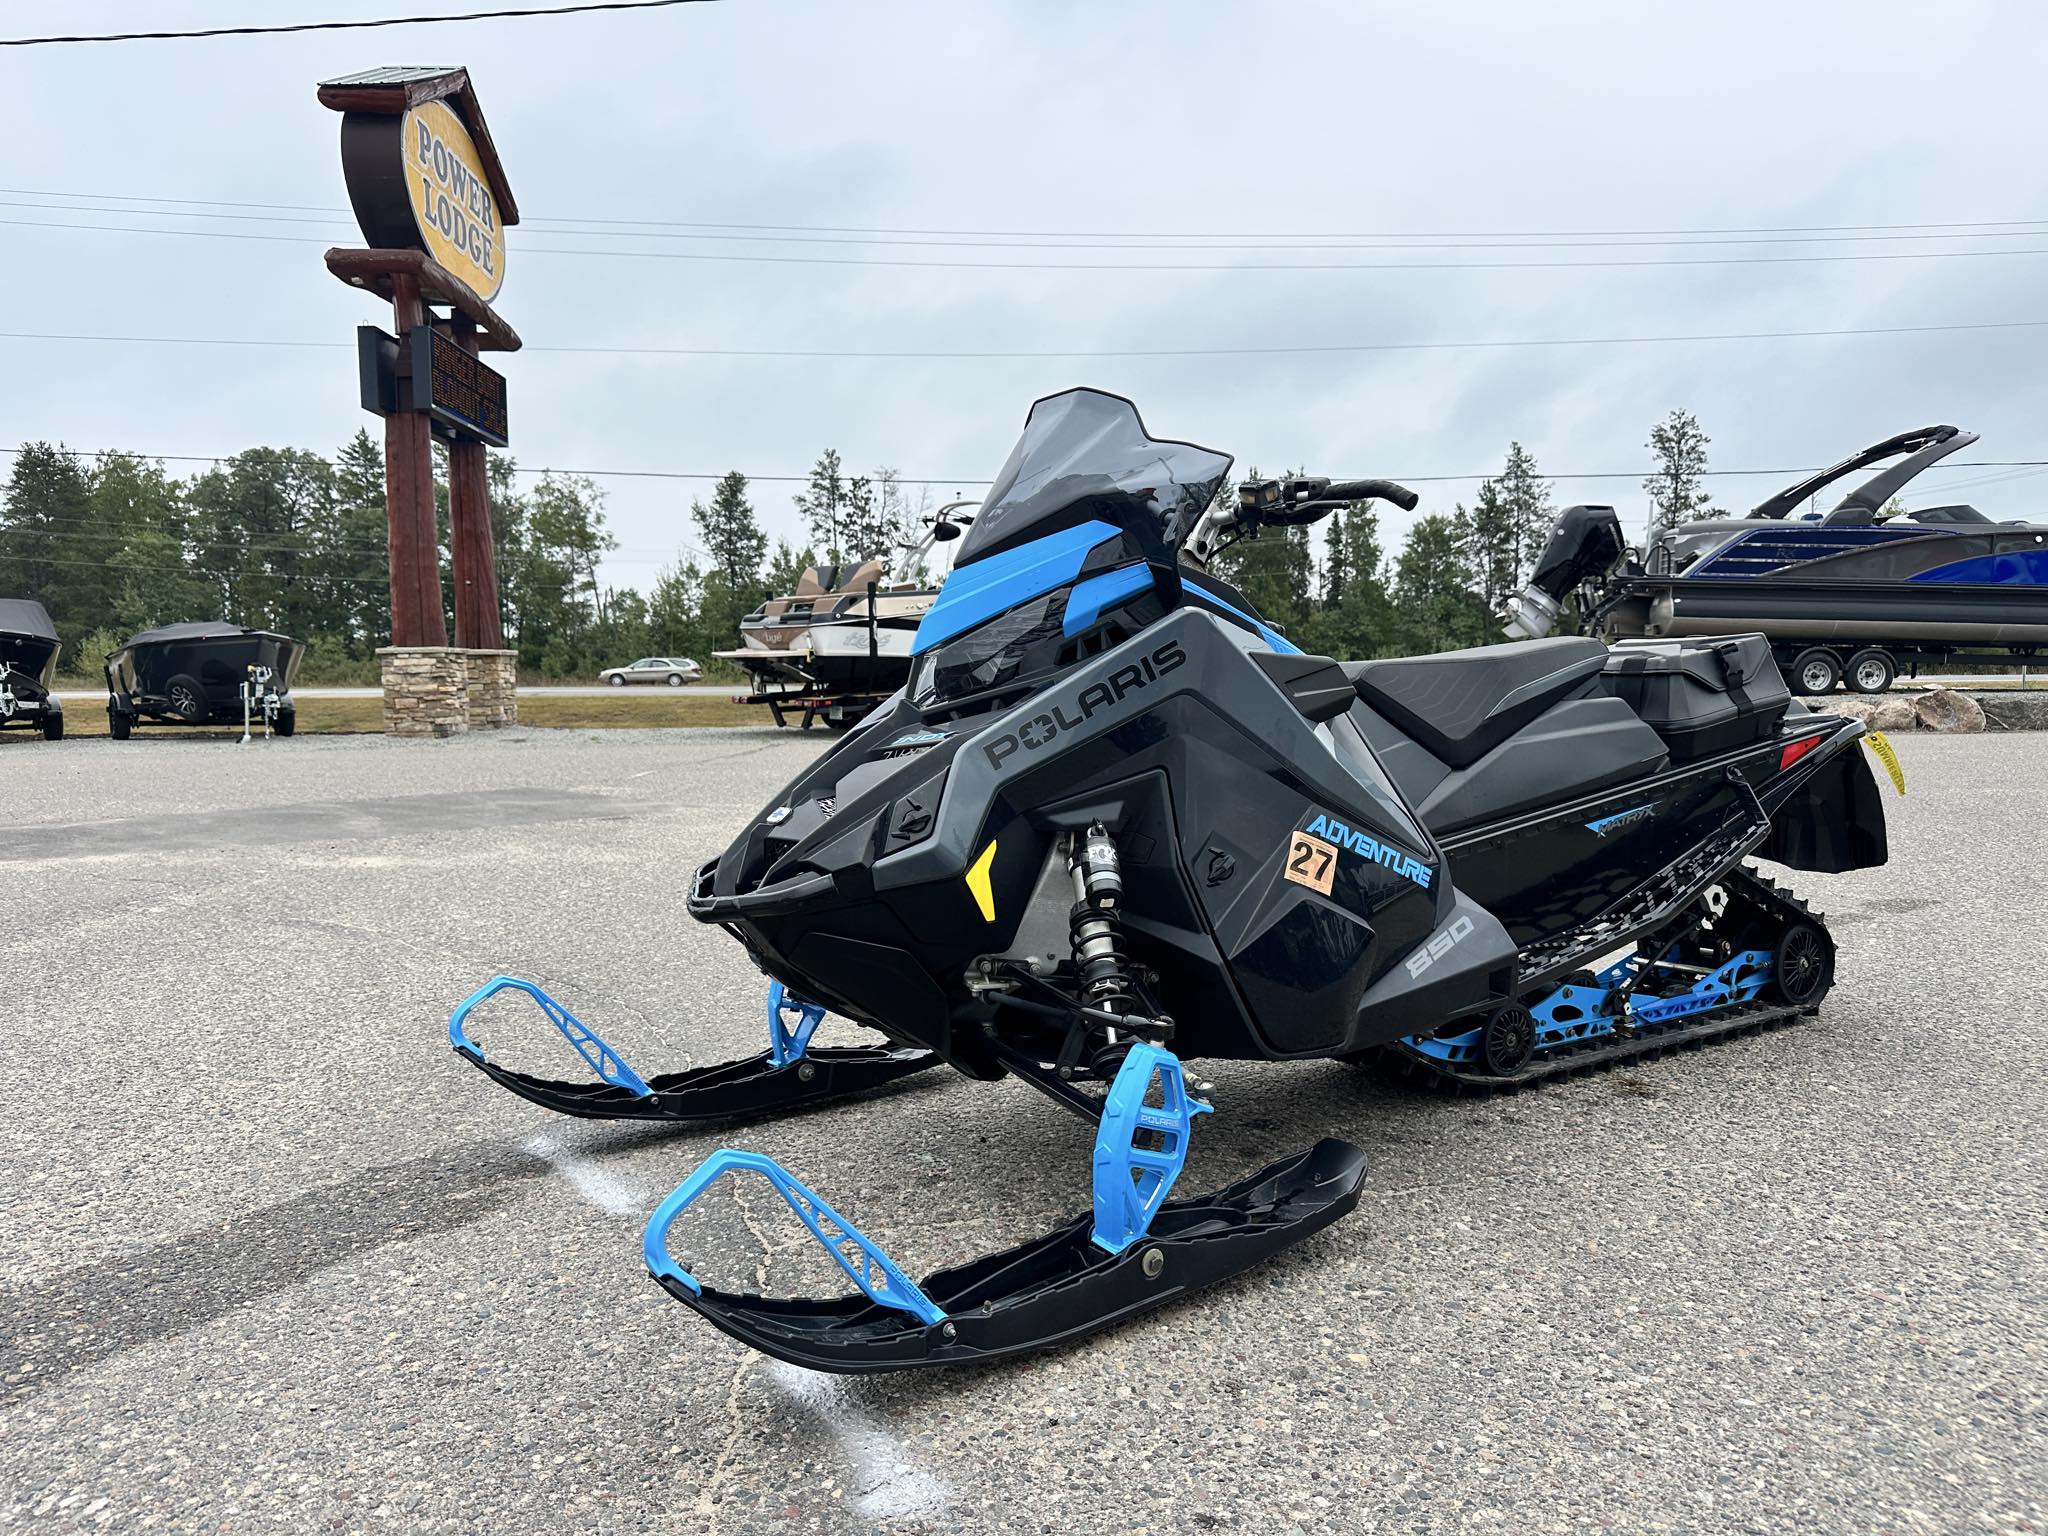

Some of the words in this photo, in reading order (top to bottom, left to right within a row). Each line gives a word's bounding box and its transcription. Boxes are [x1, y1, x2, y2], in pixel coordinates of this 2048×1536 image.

[417, 119, 494, 232] POWER
[422, 177, 494, 275] LODGE
[982, 639, 1187, 771] POLARIS
[1306, 814, 1433, 889] ADVENTURE
[1597, 804, 1656, 837] MATRYX
[1087, 846, 1118, 864] FOX
[1289, 841, 1333, 882] 27
[1405, 915, 1475, 979] 850
[889, 1264, 928, 1307] POLARIS
